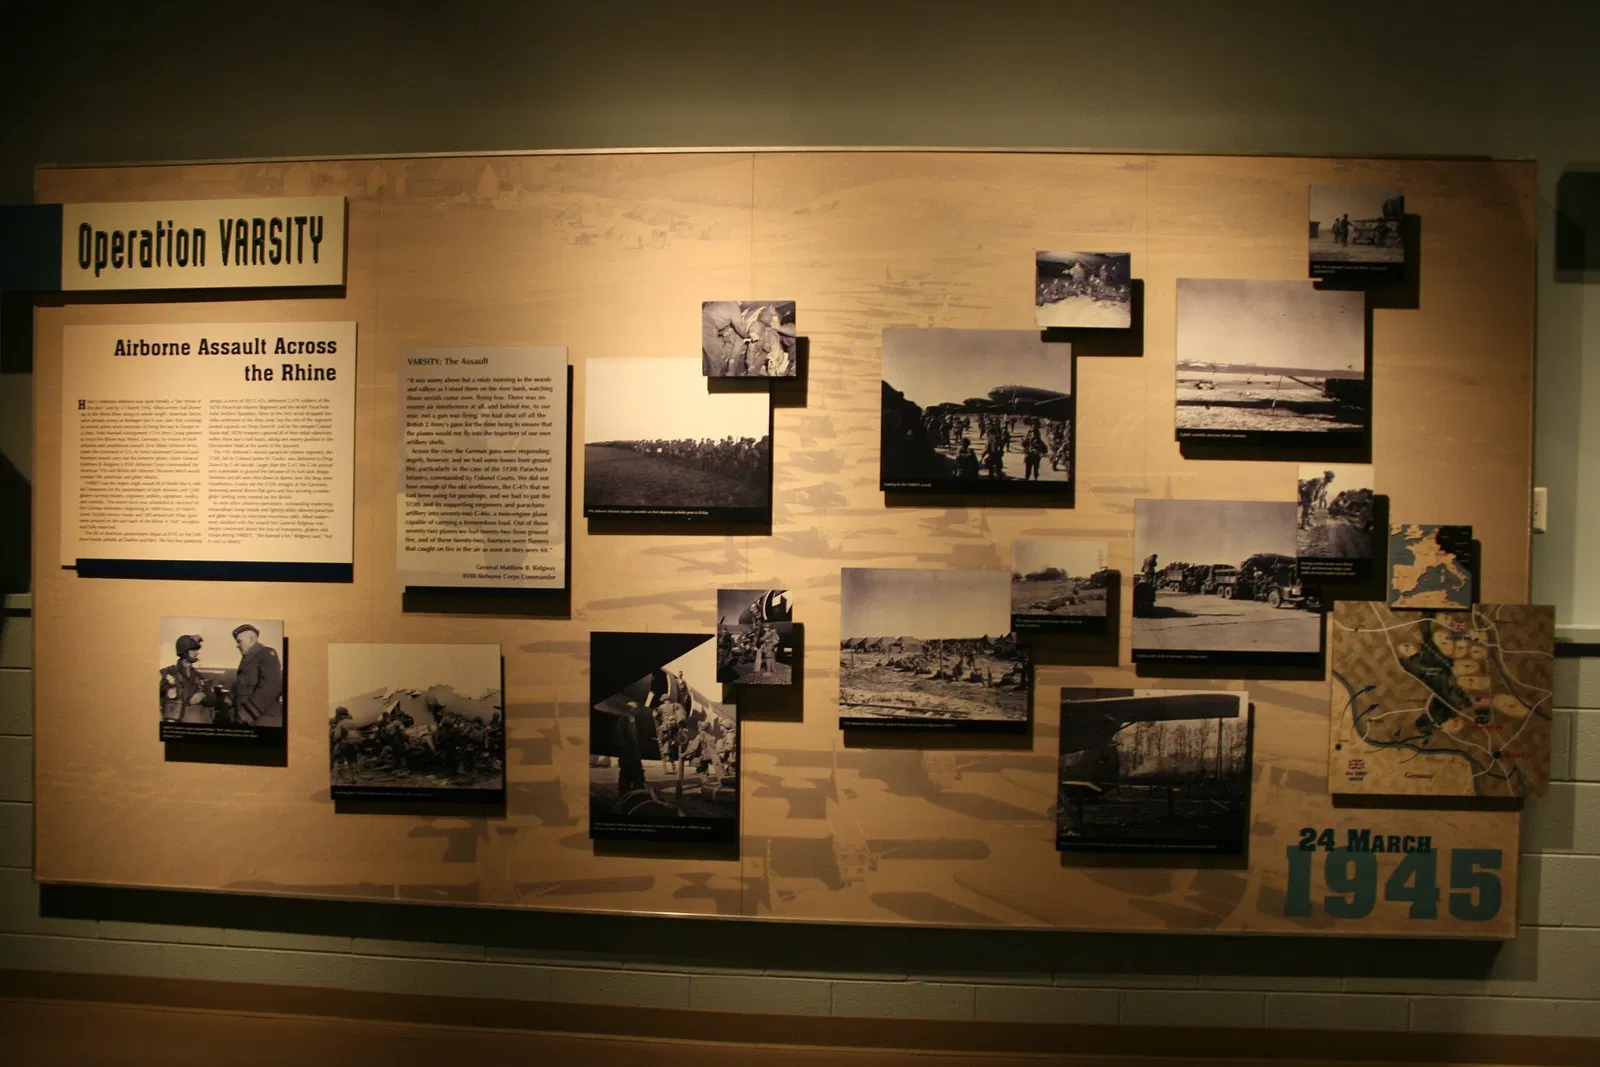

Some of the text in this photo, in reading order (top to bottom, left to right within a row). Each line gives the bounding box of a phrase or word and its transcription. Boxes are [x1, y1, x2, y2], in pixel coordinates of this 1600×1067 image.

[78, 216, 324, 278] Operation VARSITY
[114, 337, 338, 357] Airborne Assault Across
[244, 364, 337, 382] the Rhine
[1299, 827, 1432, 853] 24 MARCH
[1284, 845, 1502, 921] 1945
